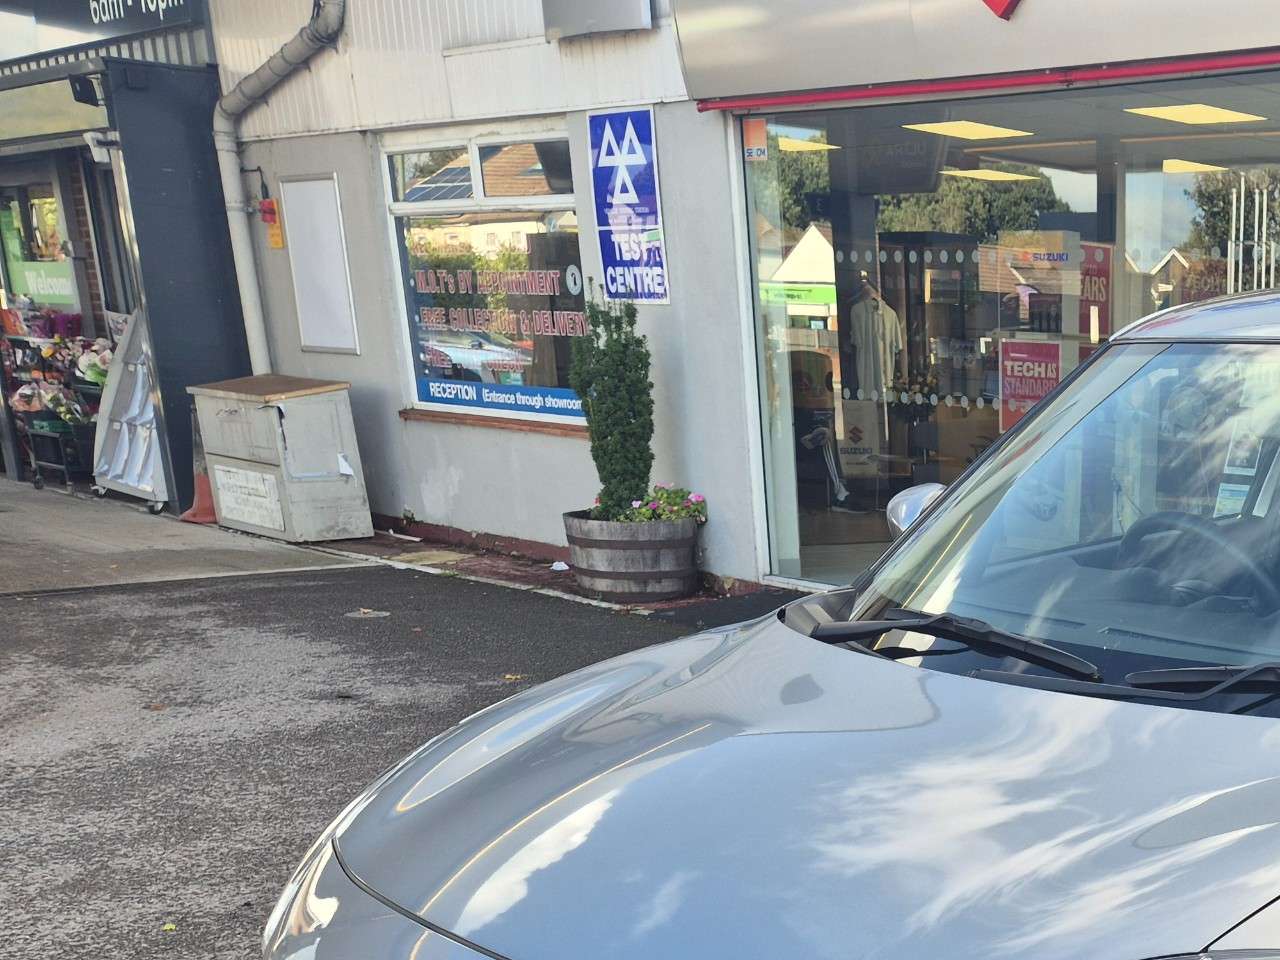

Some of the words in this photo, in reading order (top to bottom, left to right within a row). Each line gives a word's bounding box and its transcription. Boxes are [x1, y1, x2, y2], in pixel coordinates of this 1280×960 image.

[611, 233, 648, 261] TEST
[1032, 252, 1069, 261] SUZUKI
[457, 269, 473, 295] BY
[476, 269, 561, 296] APPOINTMENT
[606, 265, 666, 293] CENTRE
[420, 307, 447, 330] FREE
[450, 308, 517, 335] COLLECTION
[520, 310, 531, 335] &
[1004, 360, 1045, 378] TECH
[1047, 363, 1057, 378] AS
[429, 383, 477, 401] RECEPTION
[482, 388, 516, 405] (Entrance
[516, 392, 544, 410] through
